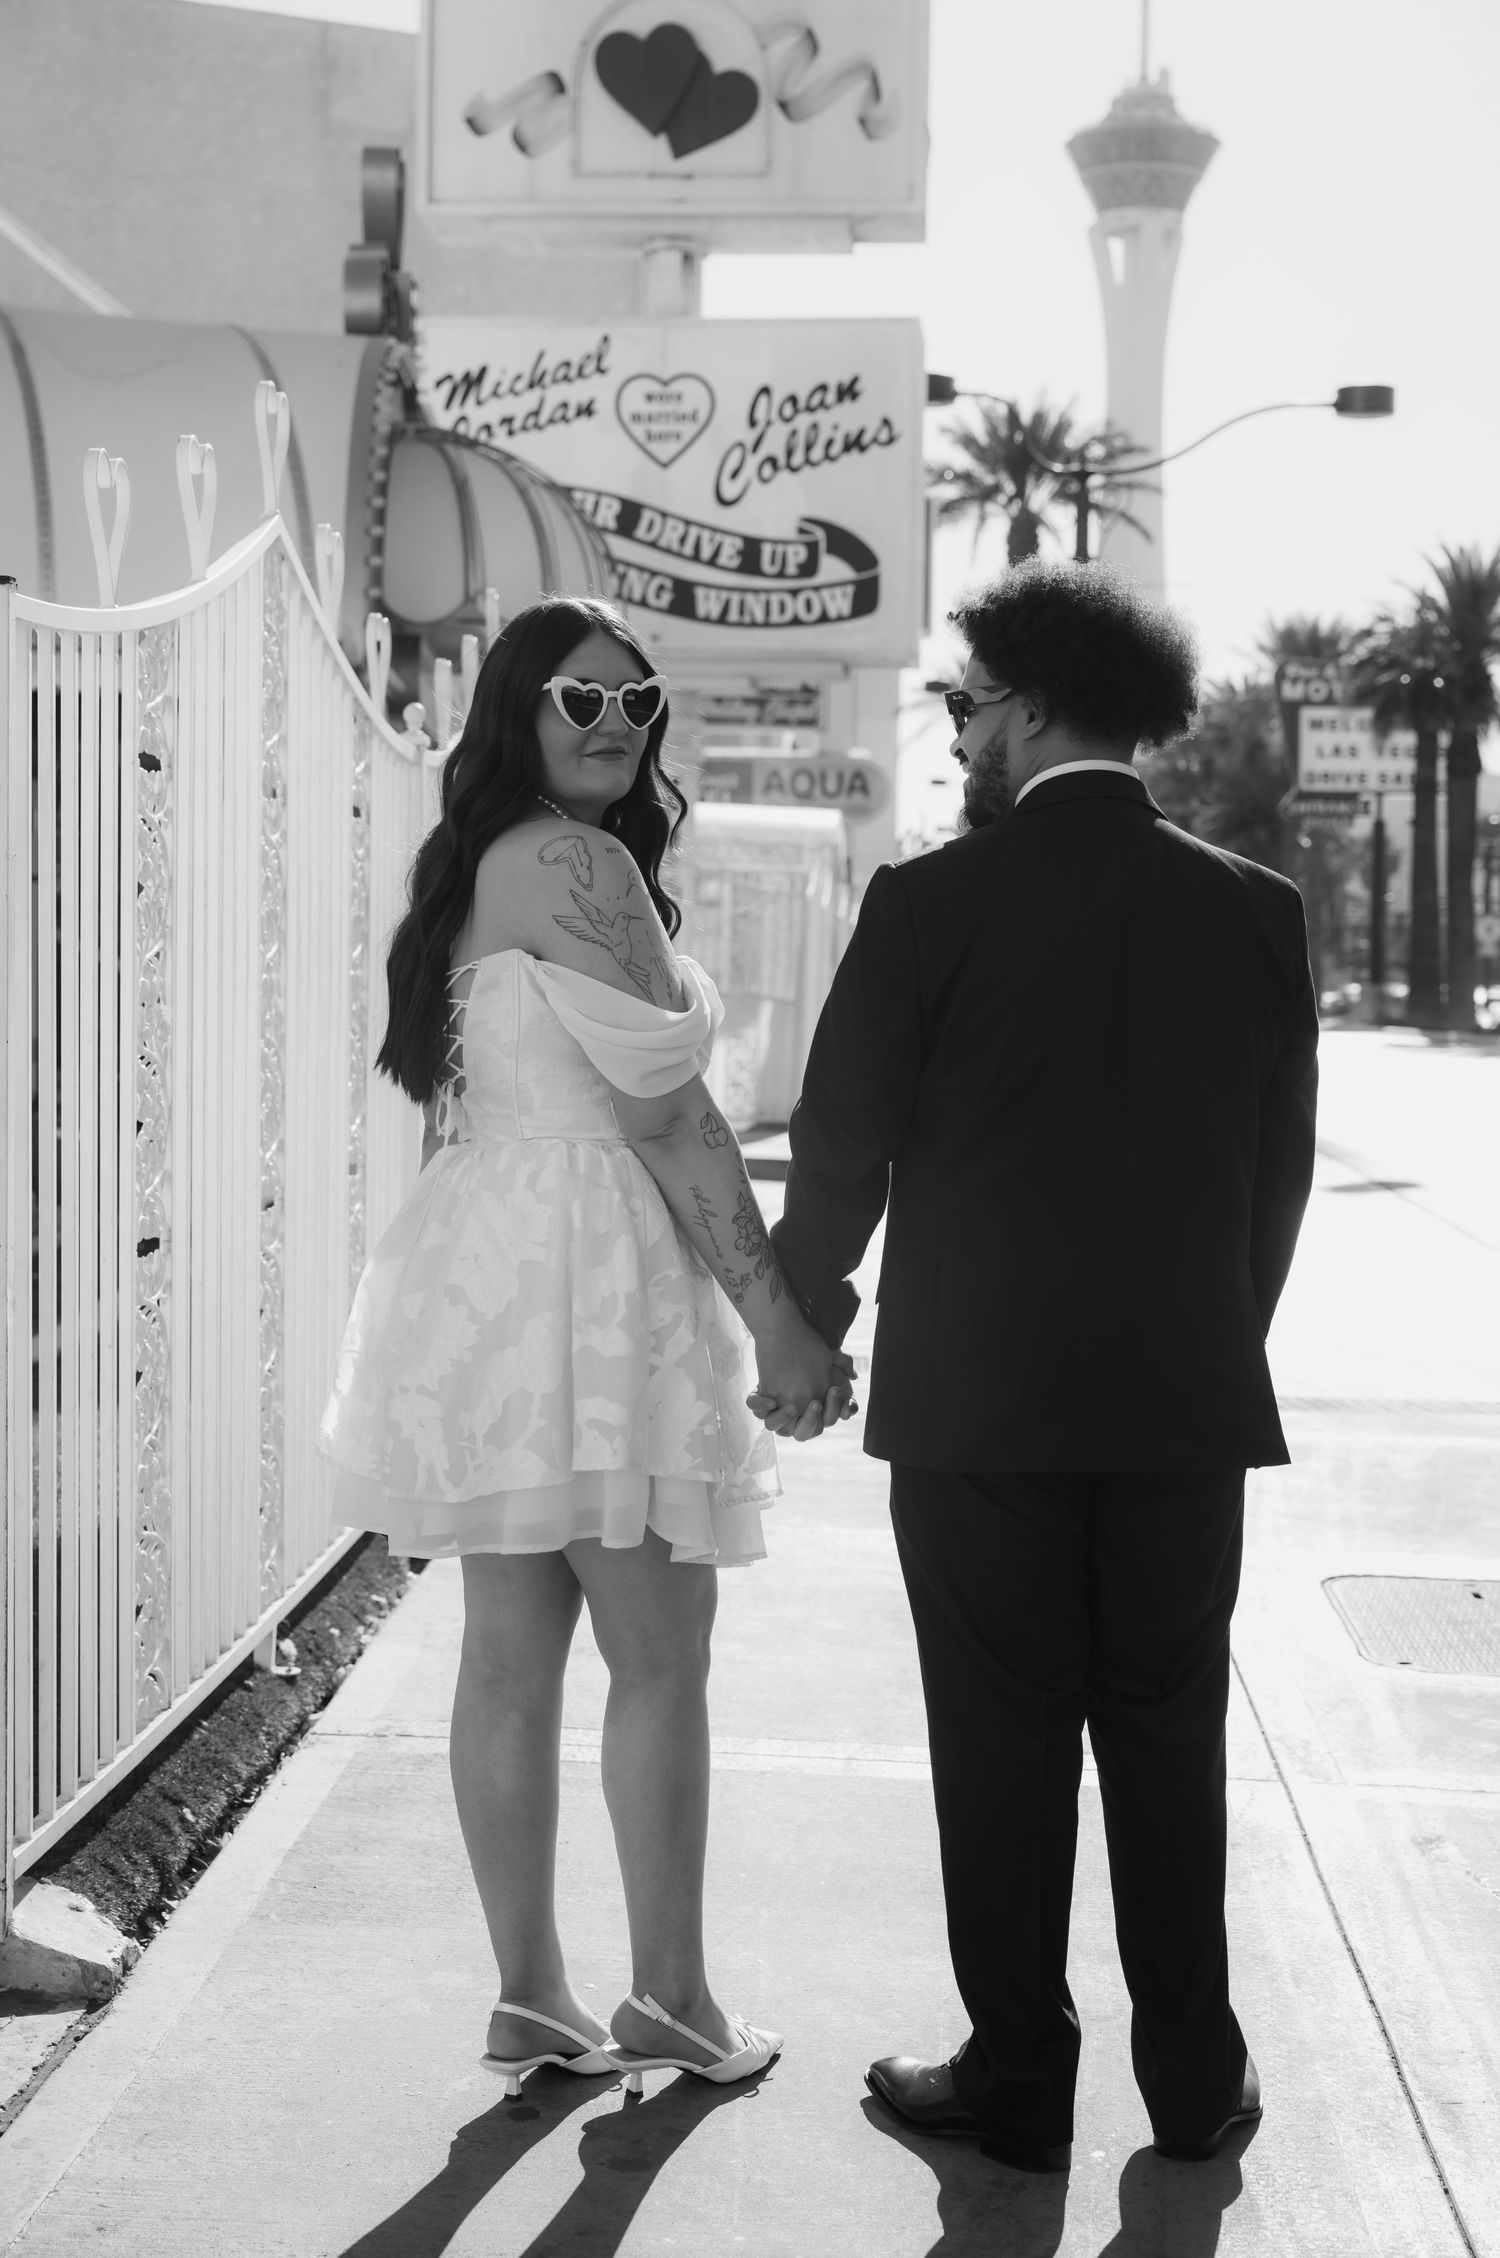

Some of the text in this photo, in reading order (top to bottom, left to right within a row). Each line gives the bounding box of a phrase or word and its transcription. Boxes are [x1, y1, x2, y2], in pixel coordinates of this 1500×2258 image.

[435, 335, 611, 410] Michael
[630, 408, 699, 423] married
[644, 391, 682, 402] were
[750, 375, 862, 454] Joan
[644, 428, 681, 443] here
[714, 417, 898, 507] Collins
[632, 507, 745, 570] DRIVE
[759, 541, 808, 577] UP
[692, 584, 856, 626] WINDOW
[762, 766, 870, 801] AQUA
